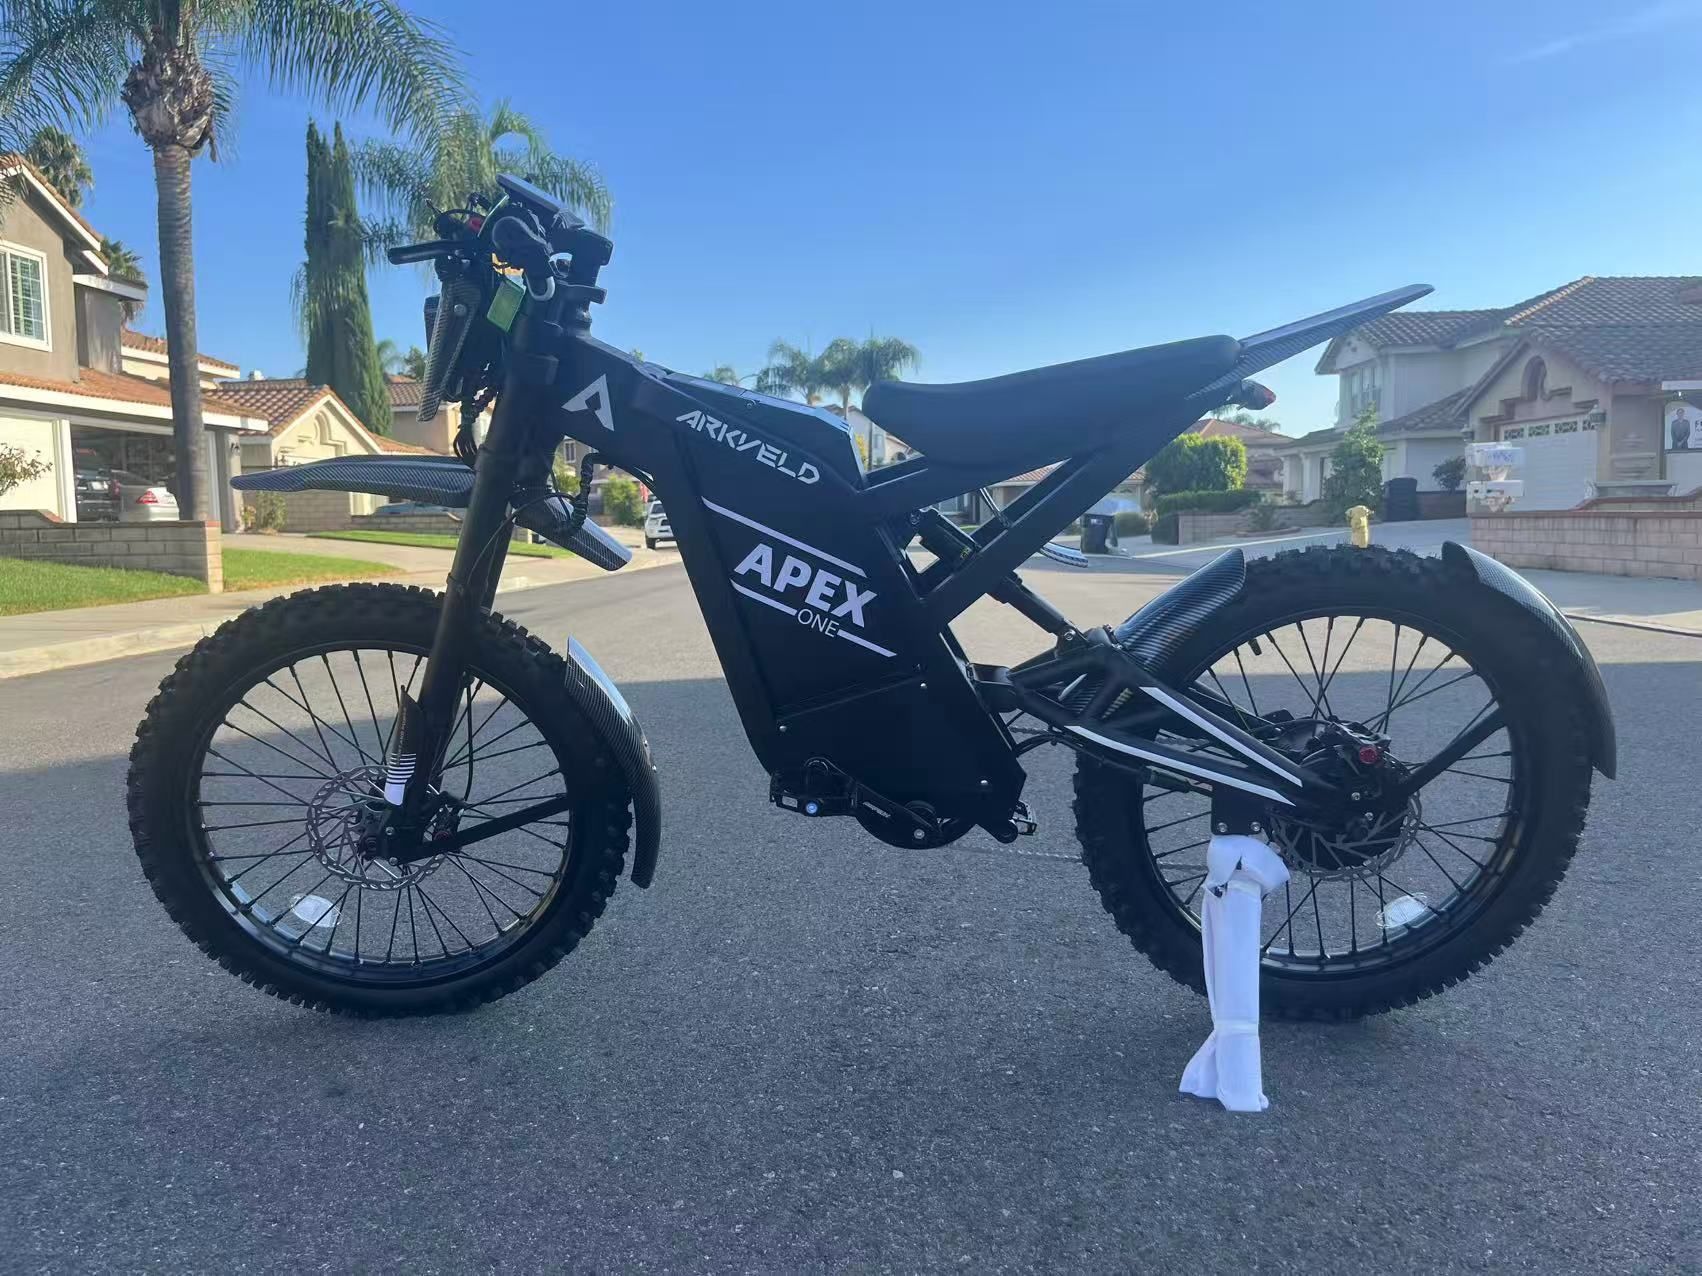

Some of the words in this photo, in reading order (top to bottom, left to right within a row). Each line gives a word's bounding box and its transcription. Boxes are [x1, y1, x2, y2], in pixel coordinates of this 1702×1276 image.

[676, 410, 820, 484] ARKVELD
[734, 543, 877, 627] APEX
[797, 608, 839, 637] ONE
